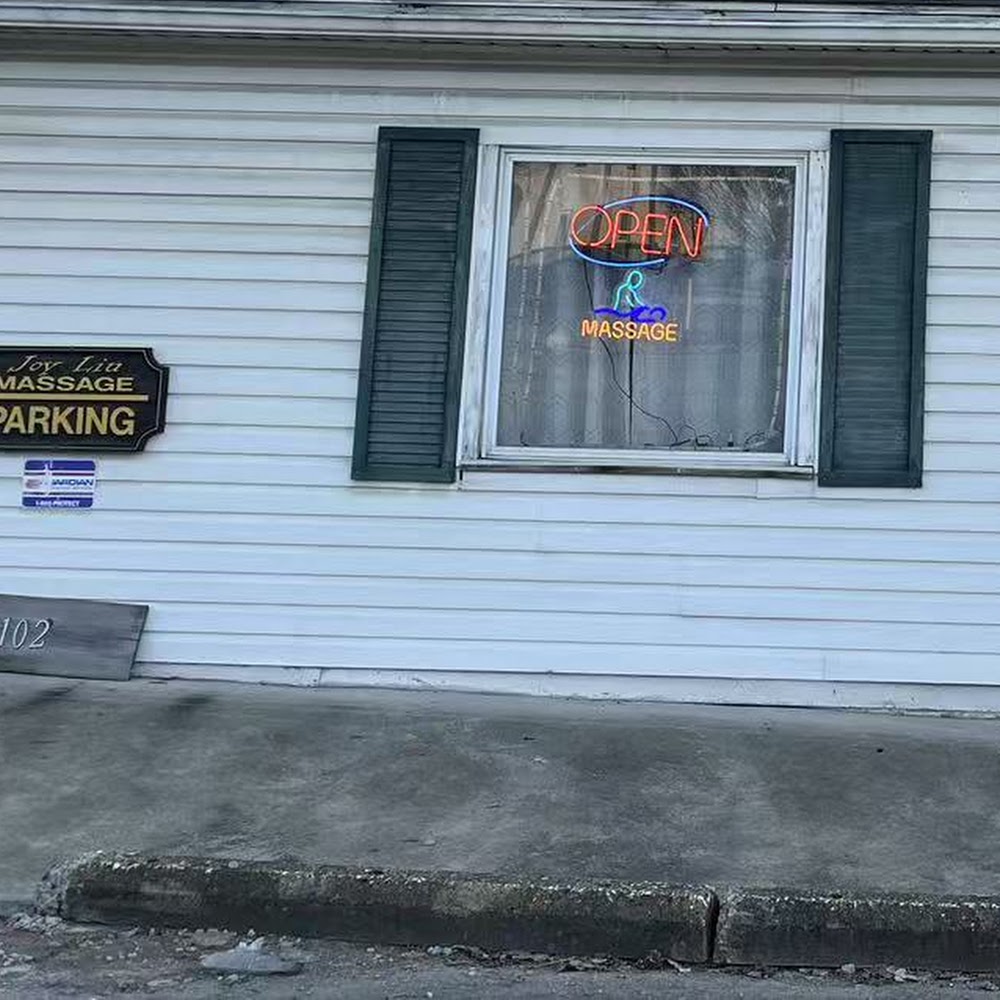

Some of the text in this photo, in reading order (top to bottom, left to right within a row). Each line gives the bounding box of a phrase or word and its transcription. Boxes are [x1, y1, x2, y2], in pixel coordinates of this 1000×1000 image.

[569, 204, 704, 258] OPEN
[581, 319, 680, 342] MASSAGE
[0, 376, 134, 392] MASSAGE
[0, 617, 51, 650] 102
